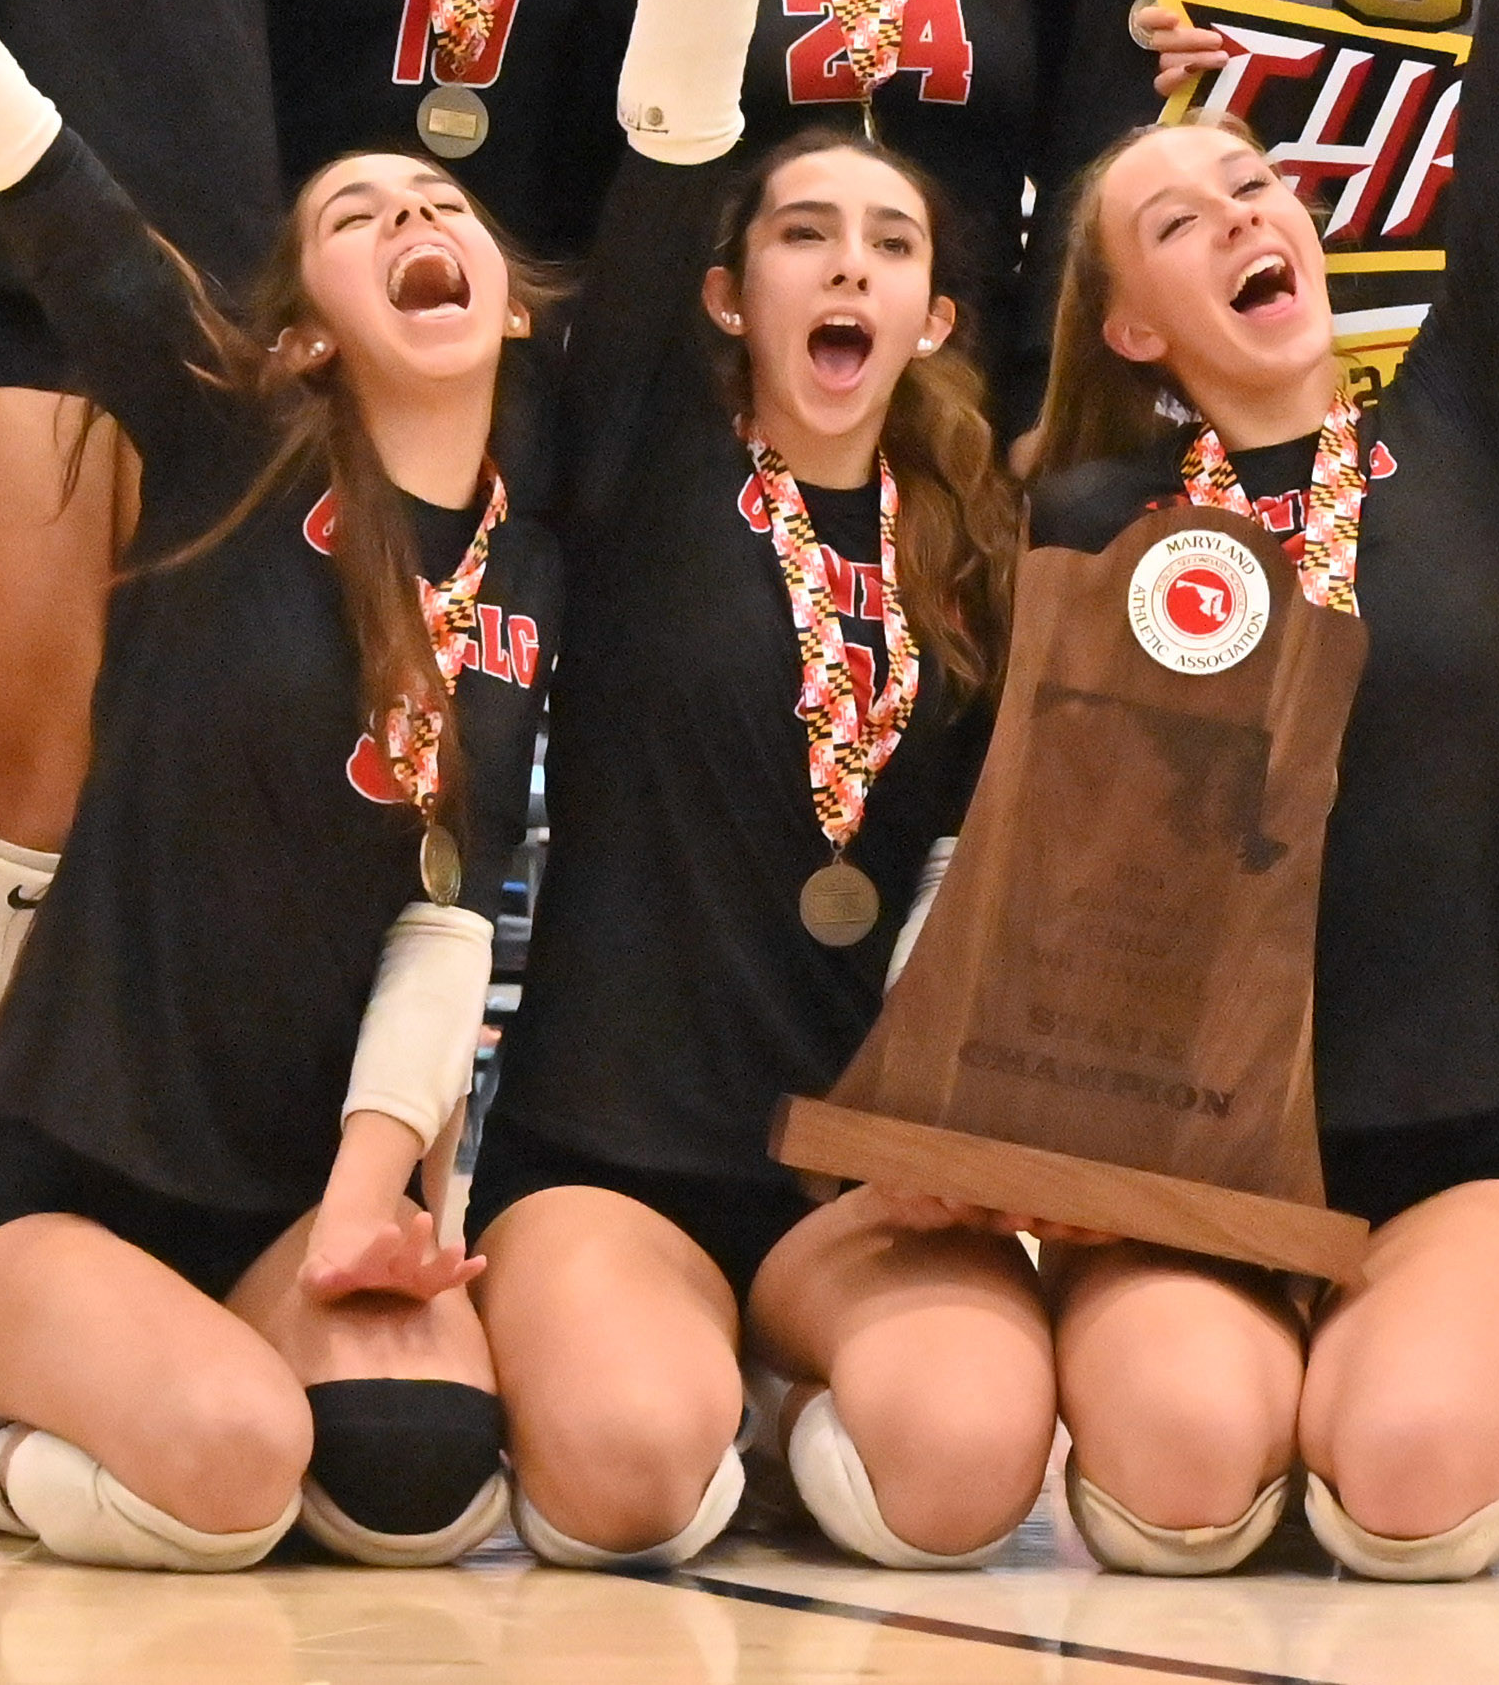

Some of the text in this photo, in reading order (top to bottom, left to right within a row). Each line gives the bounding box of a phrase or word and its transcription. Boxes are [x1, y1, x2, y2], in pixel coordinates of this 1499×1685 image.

[1166, 535, 1256, 576] MARYLAND
[1132, 583, 1264, 669] ATHLETIC ASSOCIATION
[958, 1039, 1235, 1120] CHAMPION
